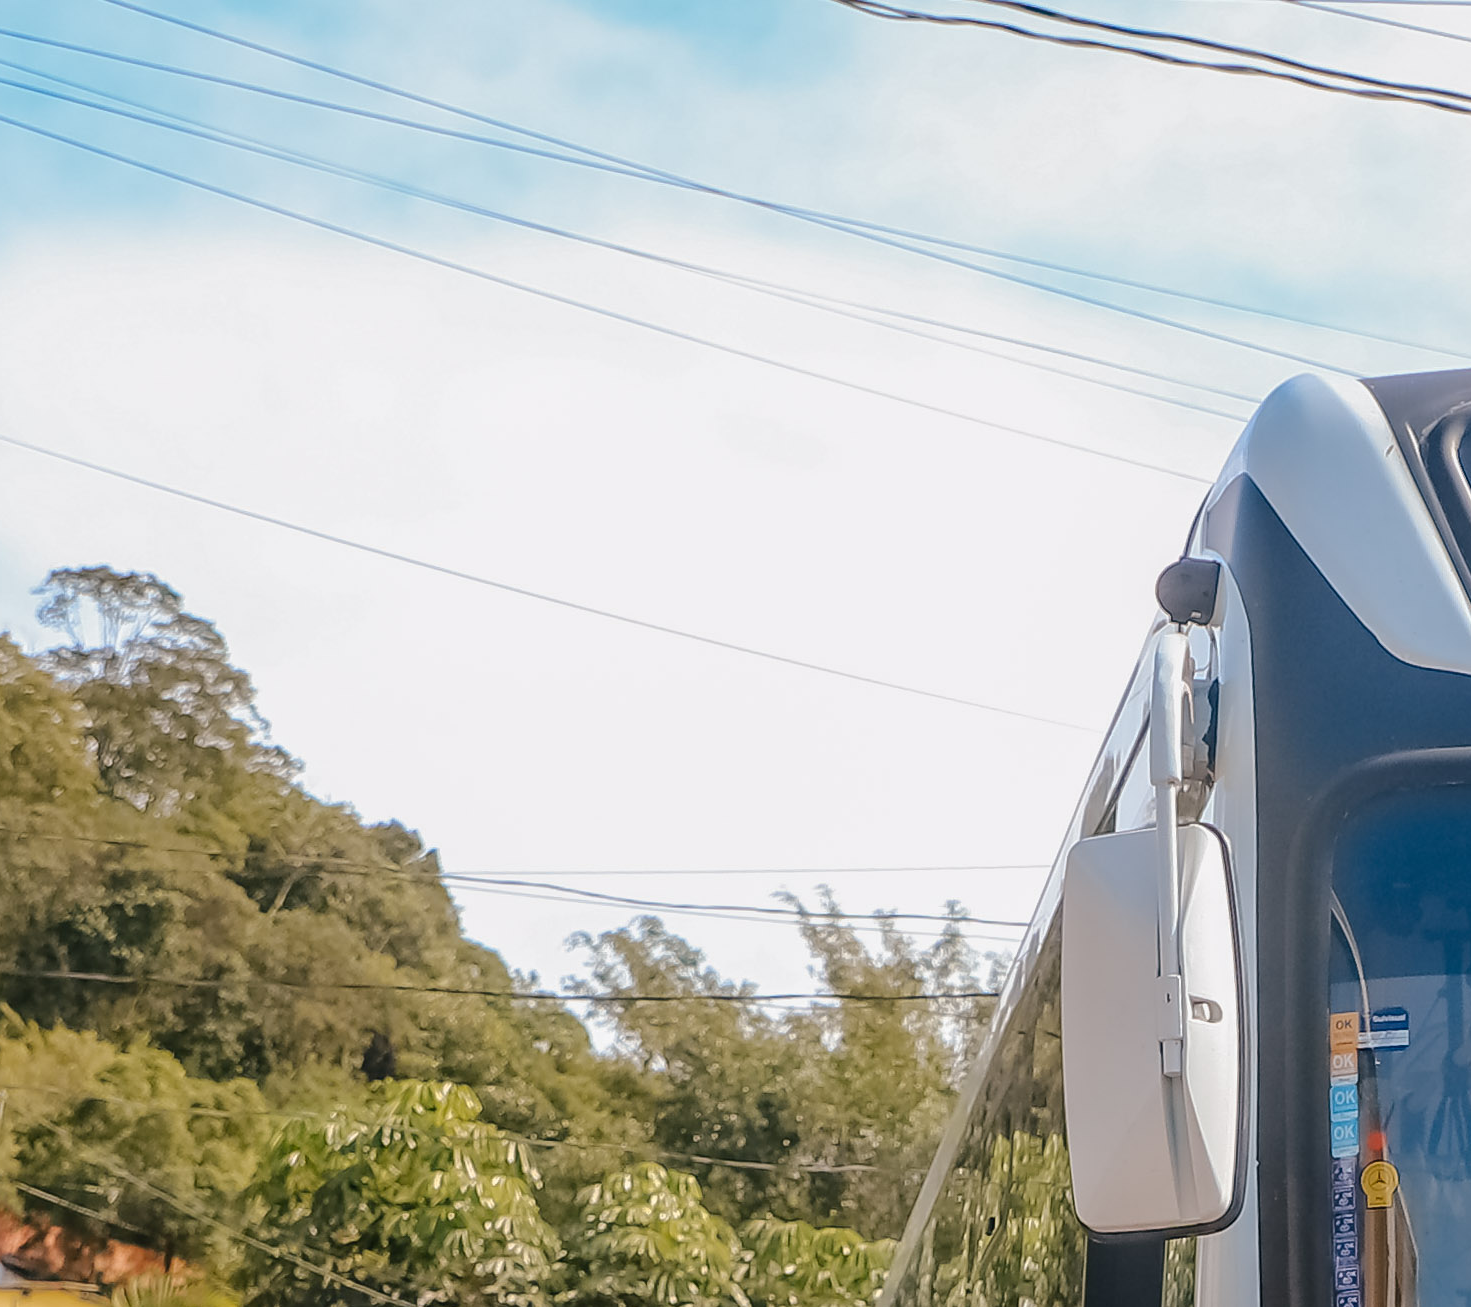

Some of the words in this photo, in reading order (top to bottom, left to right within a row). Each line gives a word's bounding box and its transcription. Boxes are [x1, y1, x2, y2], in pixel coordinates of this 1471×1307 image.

[1335, 1020, 1352, 1030] OK
[1332, 1053, 1355, 1069] OK
[1334, 1090, 1356, 1105] OK
[1333, 1125, 1355, 1140] OK
